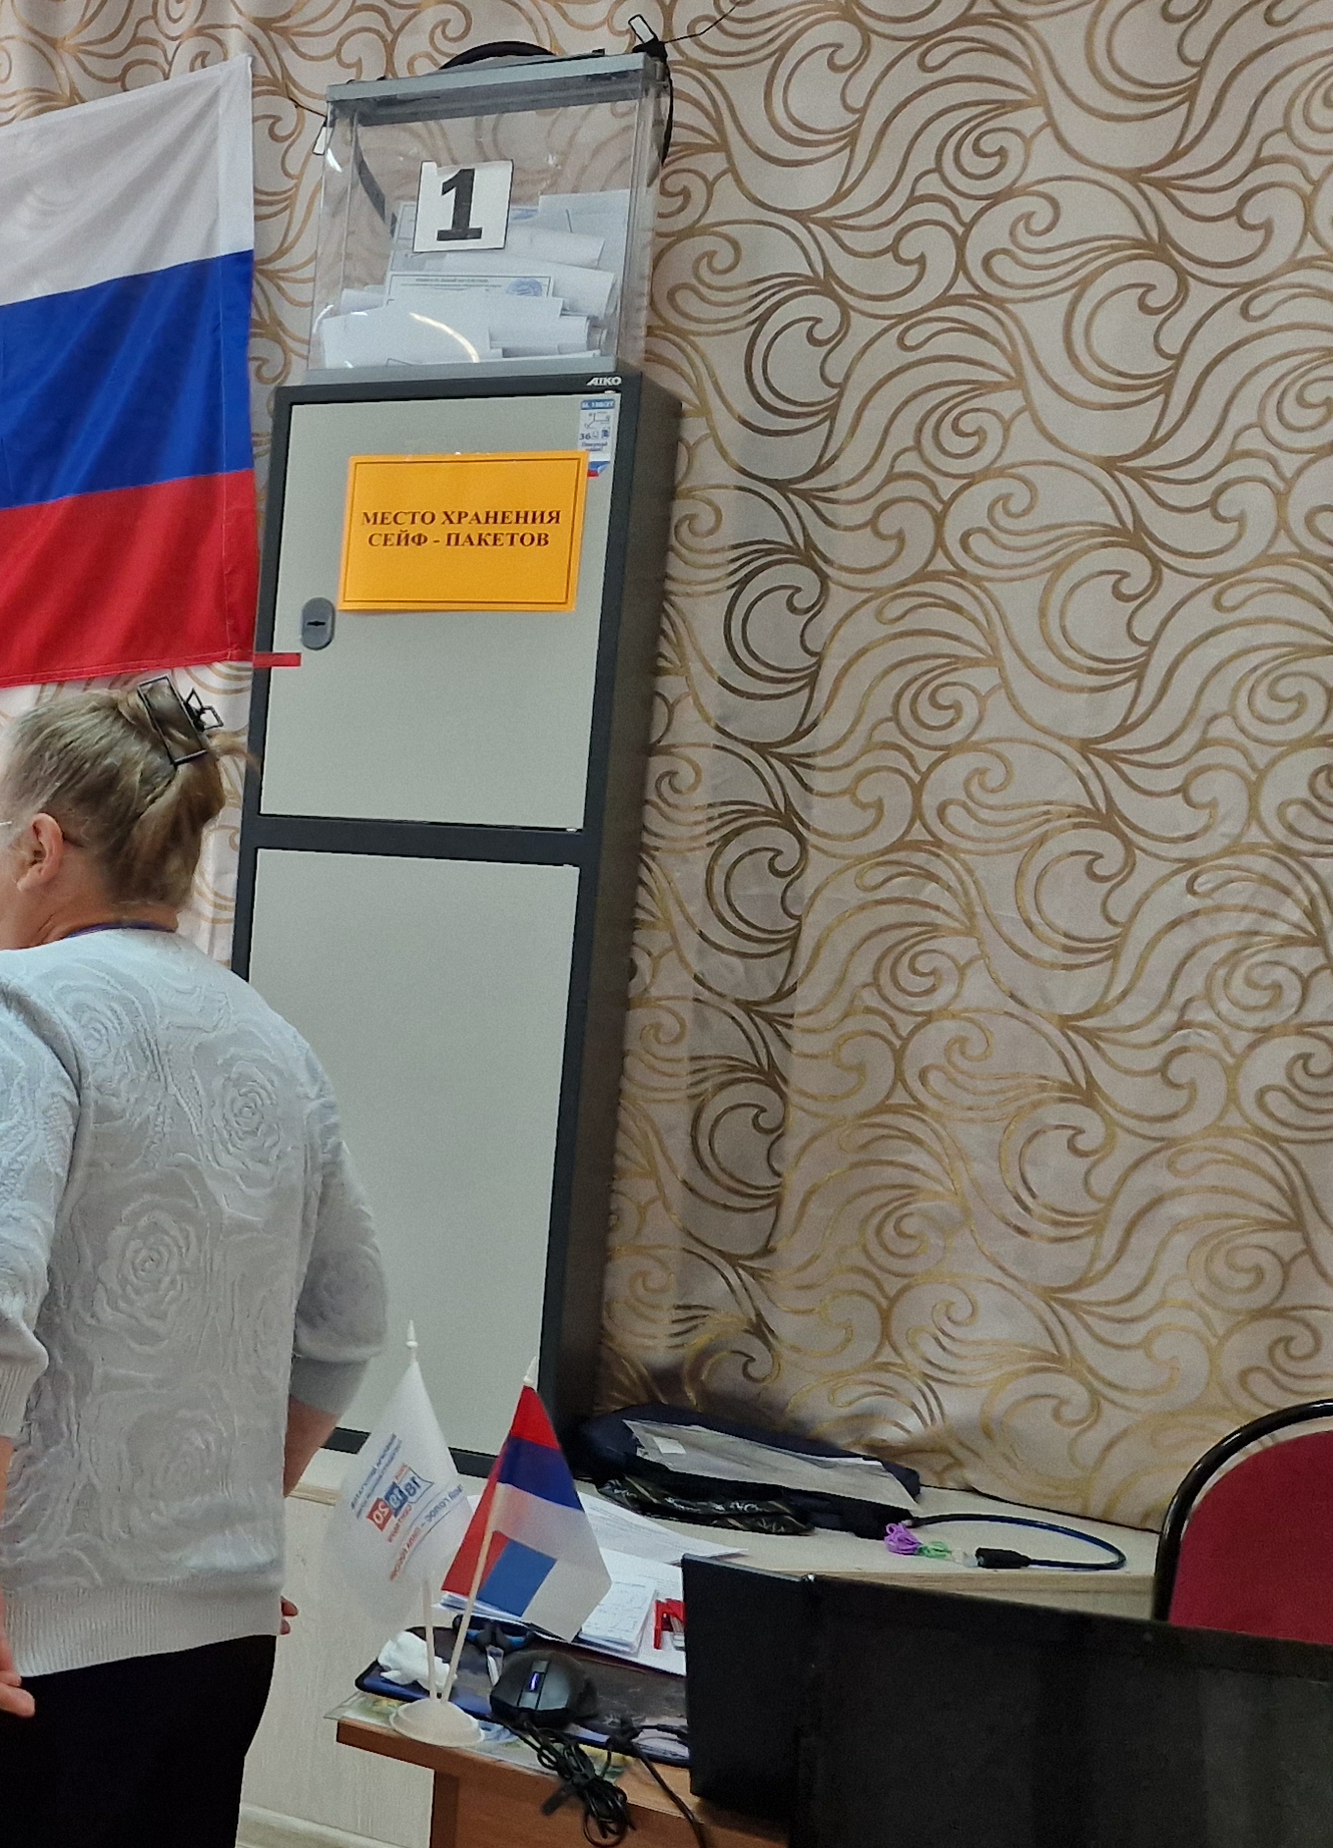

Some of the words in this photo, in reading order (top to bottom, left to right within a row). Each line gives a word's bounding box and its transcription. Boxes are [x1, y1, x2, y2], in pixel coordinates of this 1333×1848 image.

[436, 168, 483, 241] 1
[586, 376, 622, 386] AIKO
[361, 510, 437, 526] МЕСТО
[441, 510, 562, 525] ХРАНЕНИЯ
[368, 529, 429, 547] СЕЙФ
[445, 532, 550, 547] ПАКЕТОВ
